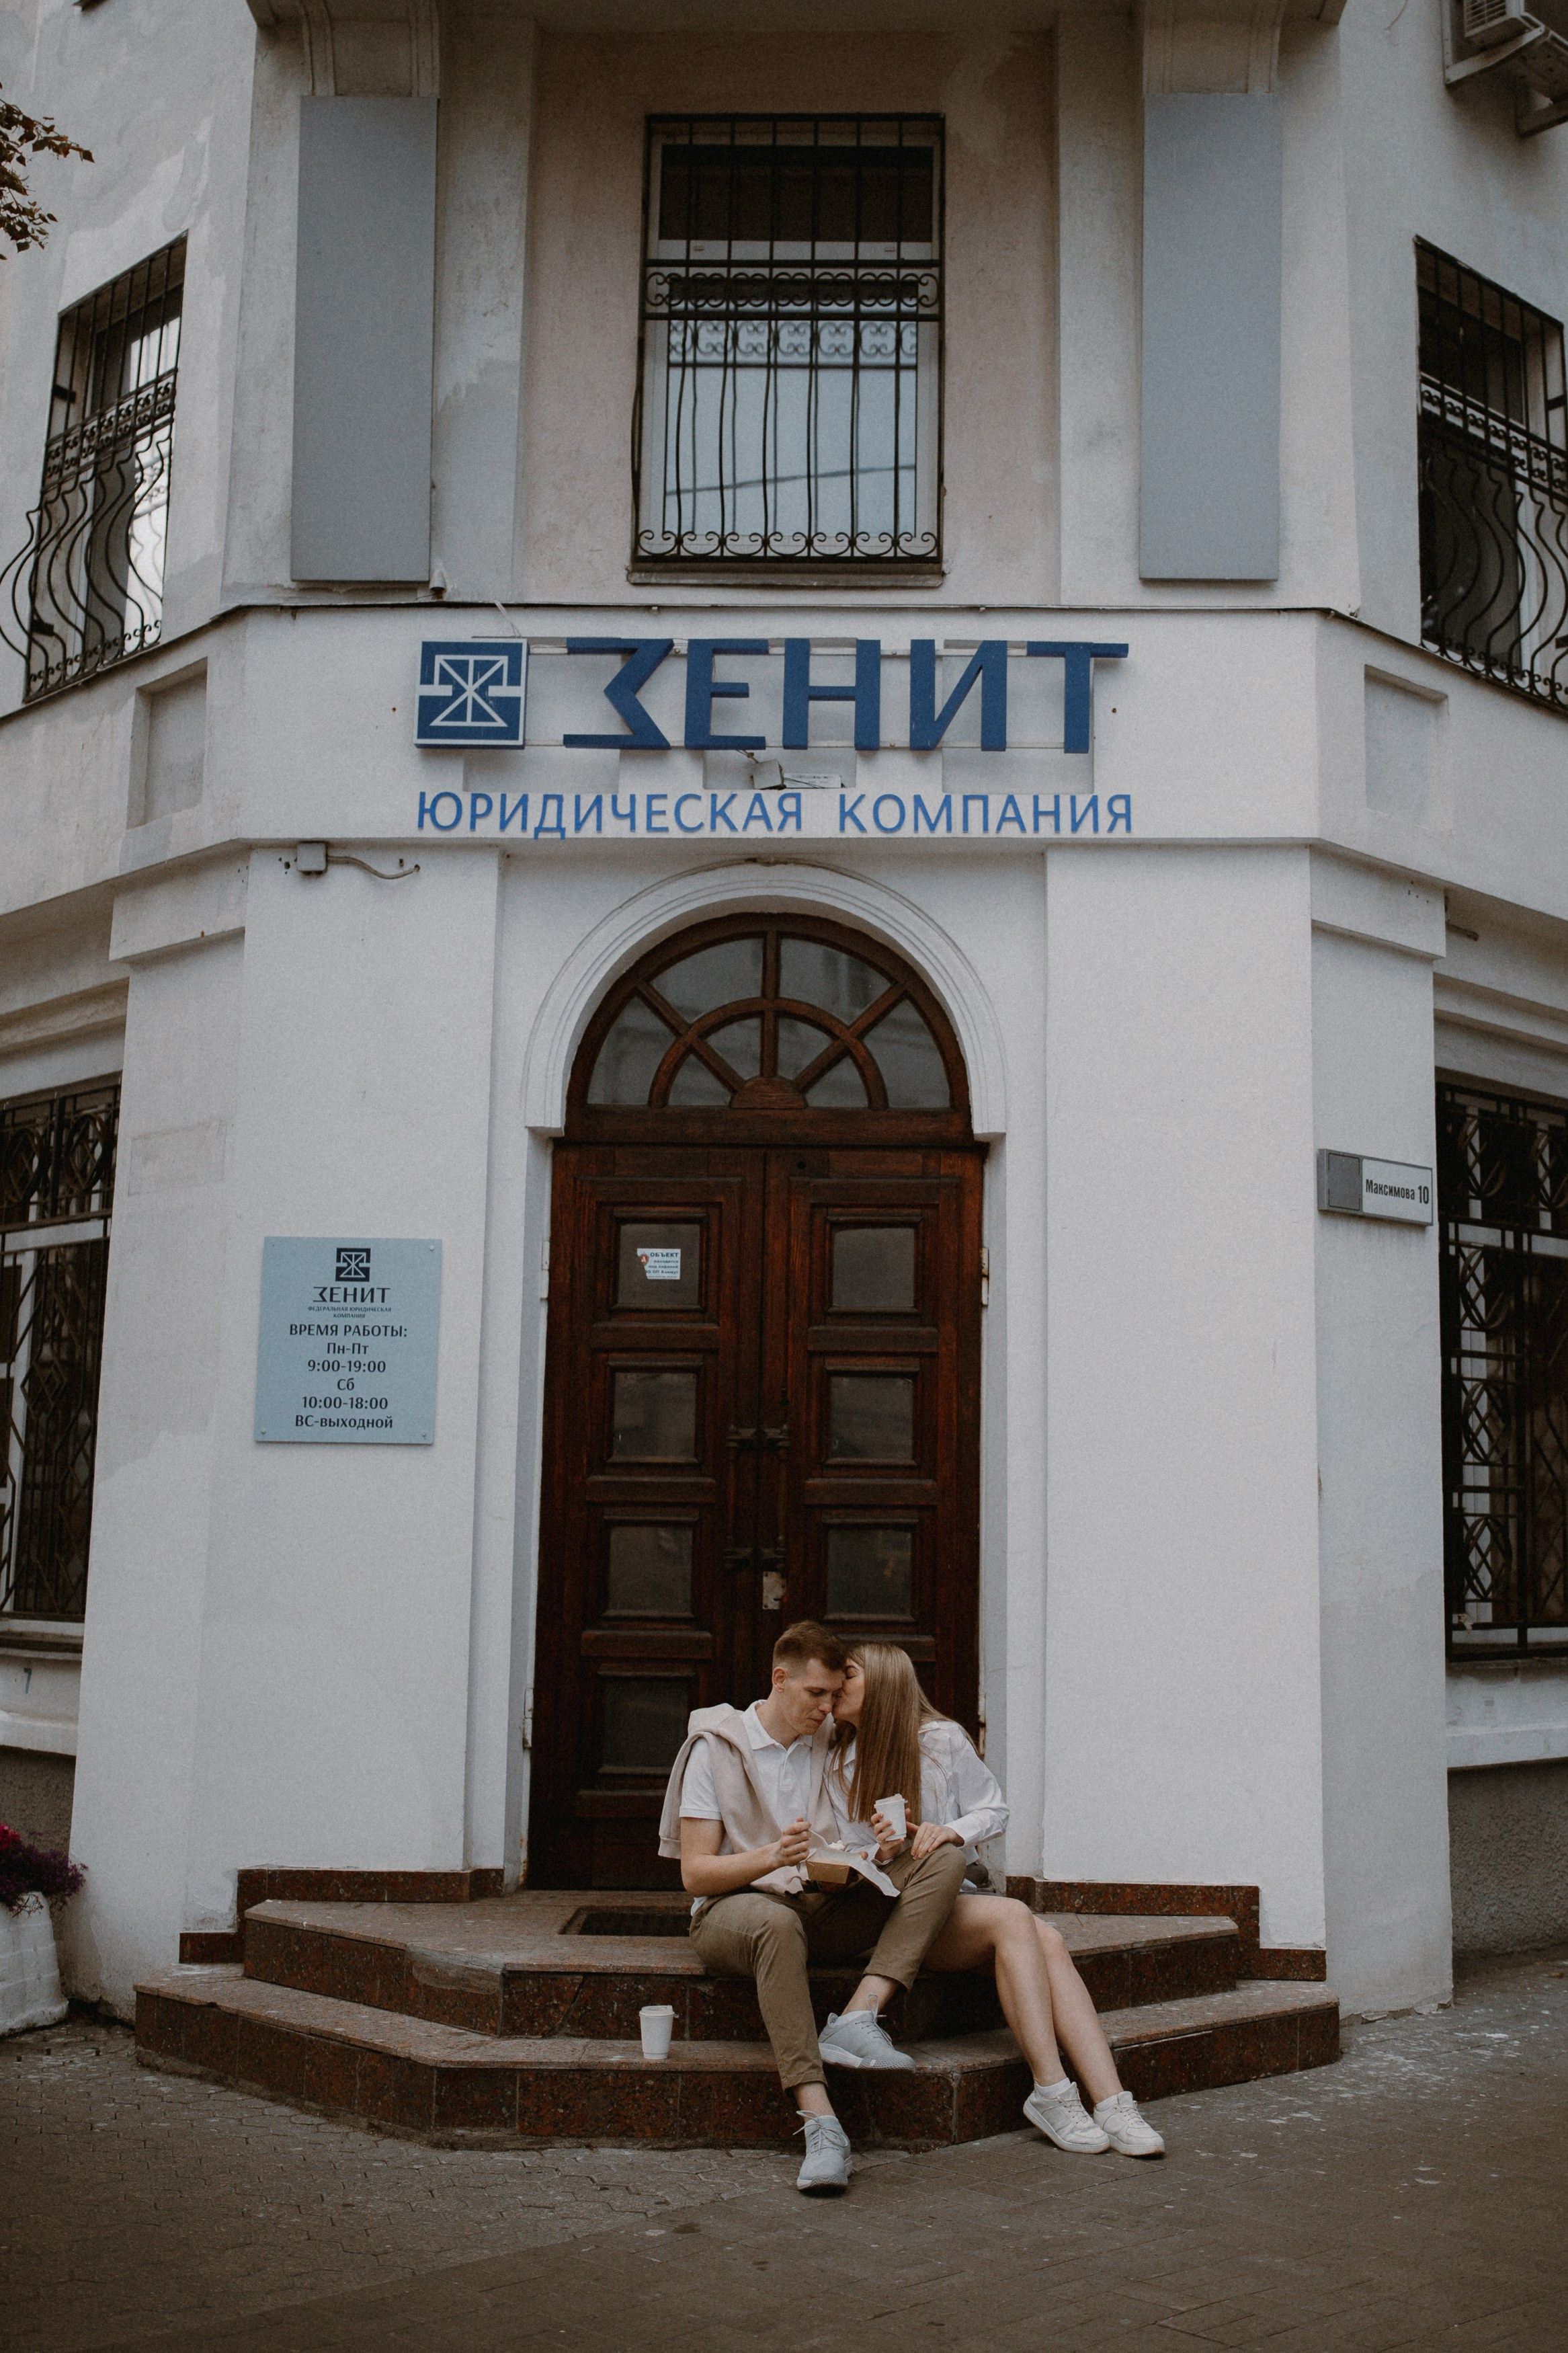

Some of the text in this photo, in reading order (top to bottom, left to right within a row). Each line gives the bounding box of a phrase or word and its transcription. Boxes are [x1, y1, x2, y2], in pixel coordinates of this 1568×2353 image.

[563, 638, 1129, 754] ЗЕНИТ
[417, 791, 1132, 840] ЮРИДИЧЕСКАЯ КОМПАНИЯ
[1366, 1179, 1429, 1204] Максимова 10
[313, 1287, 390, 1303] ЗЕНИТ
[290, 1324, 407, 1337] ВРЕМЯ РАБОТЫ:
[327, 1343, 369, 1355] Пн-Пт
[308, 1359, 386, 1372] 9:00-19:00
[337, 1378, 355, 1390] Сб
[302, 1396, 388, 1409] 10:00-18:00
[295, 1415, 393, 1429] ВС-выходной
